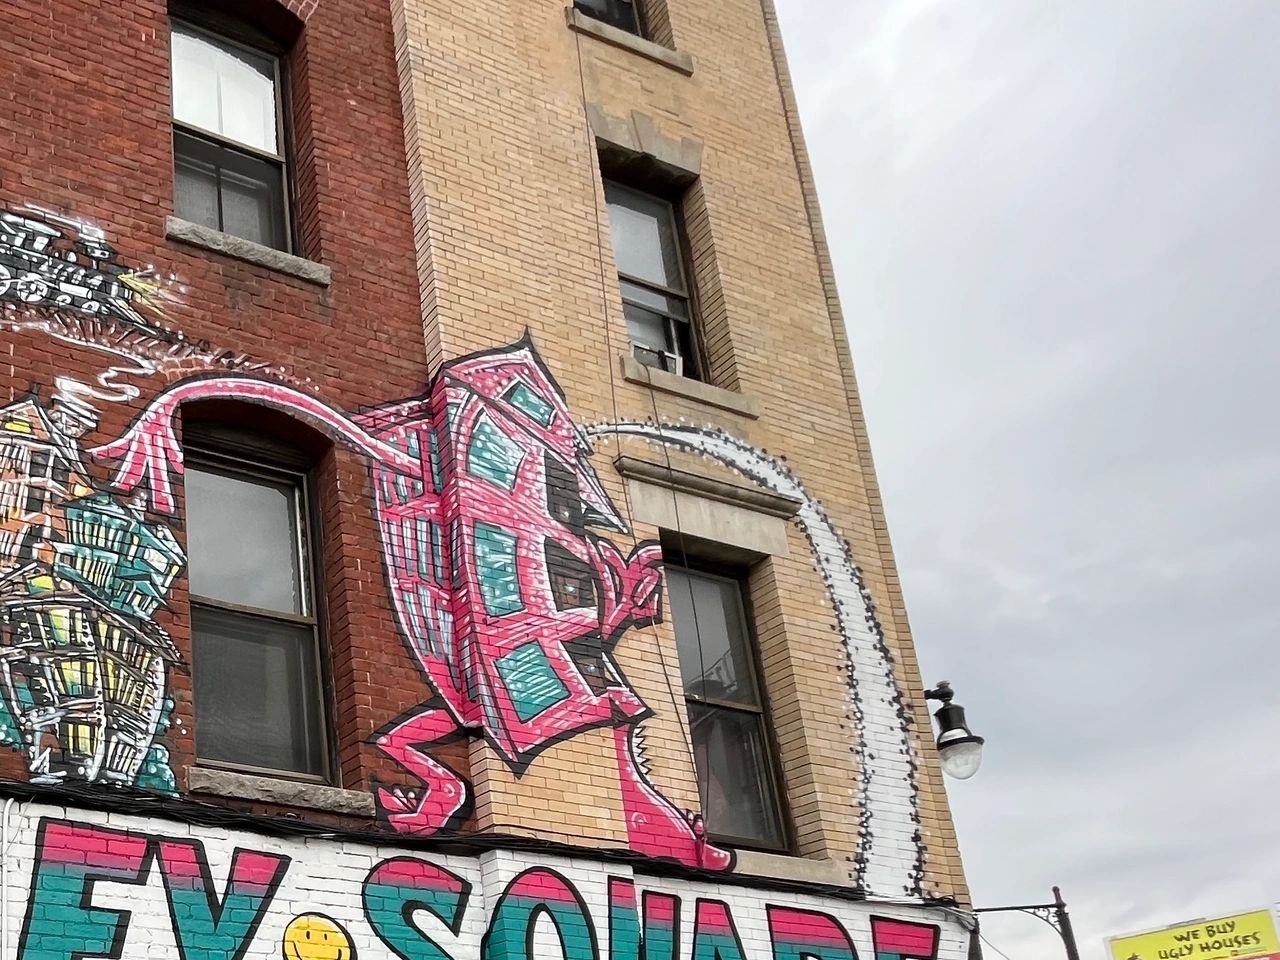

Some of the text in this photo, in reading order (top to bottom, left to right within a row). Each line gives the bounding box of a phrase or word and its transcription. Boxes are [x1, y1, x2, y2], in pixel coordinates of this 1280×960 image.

[1174, 921, 1236, 942] WE BUY
[1159, 945, 1194, 960] UGLY
[1200, 932, 1261, 952] HOUSES
